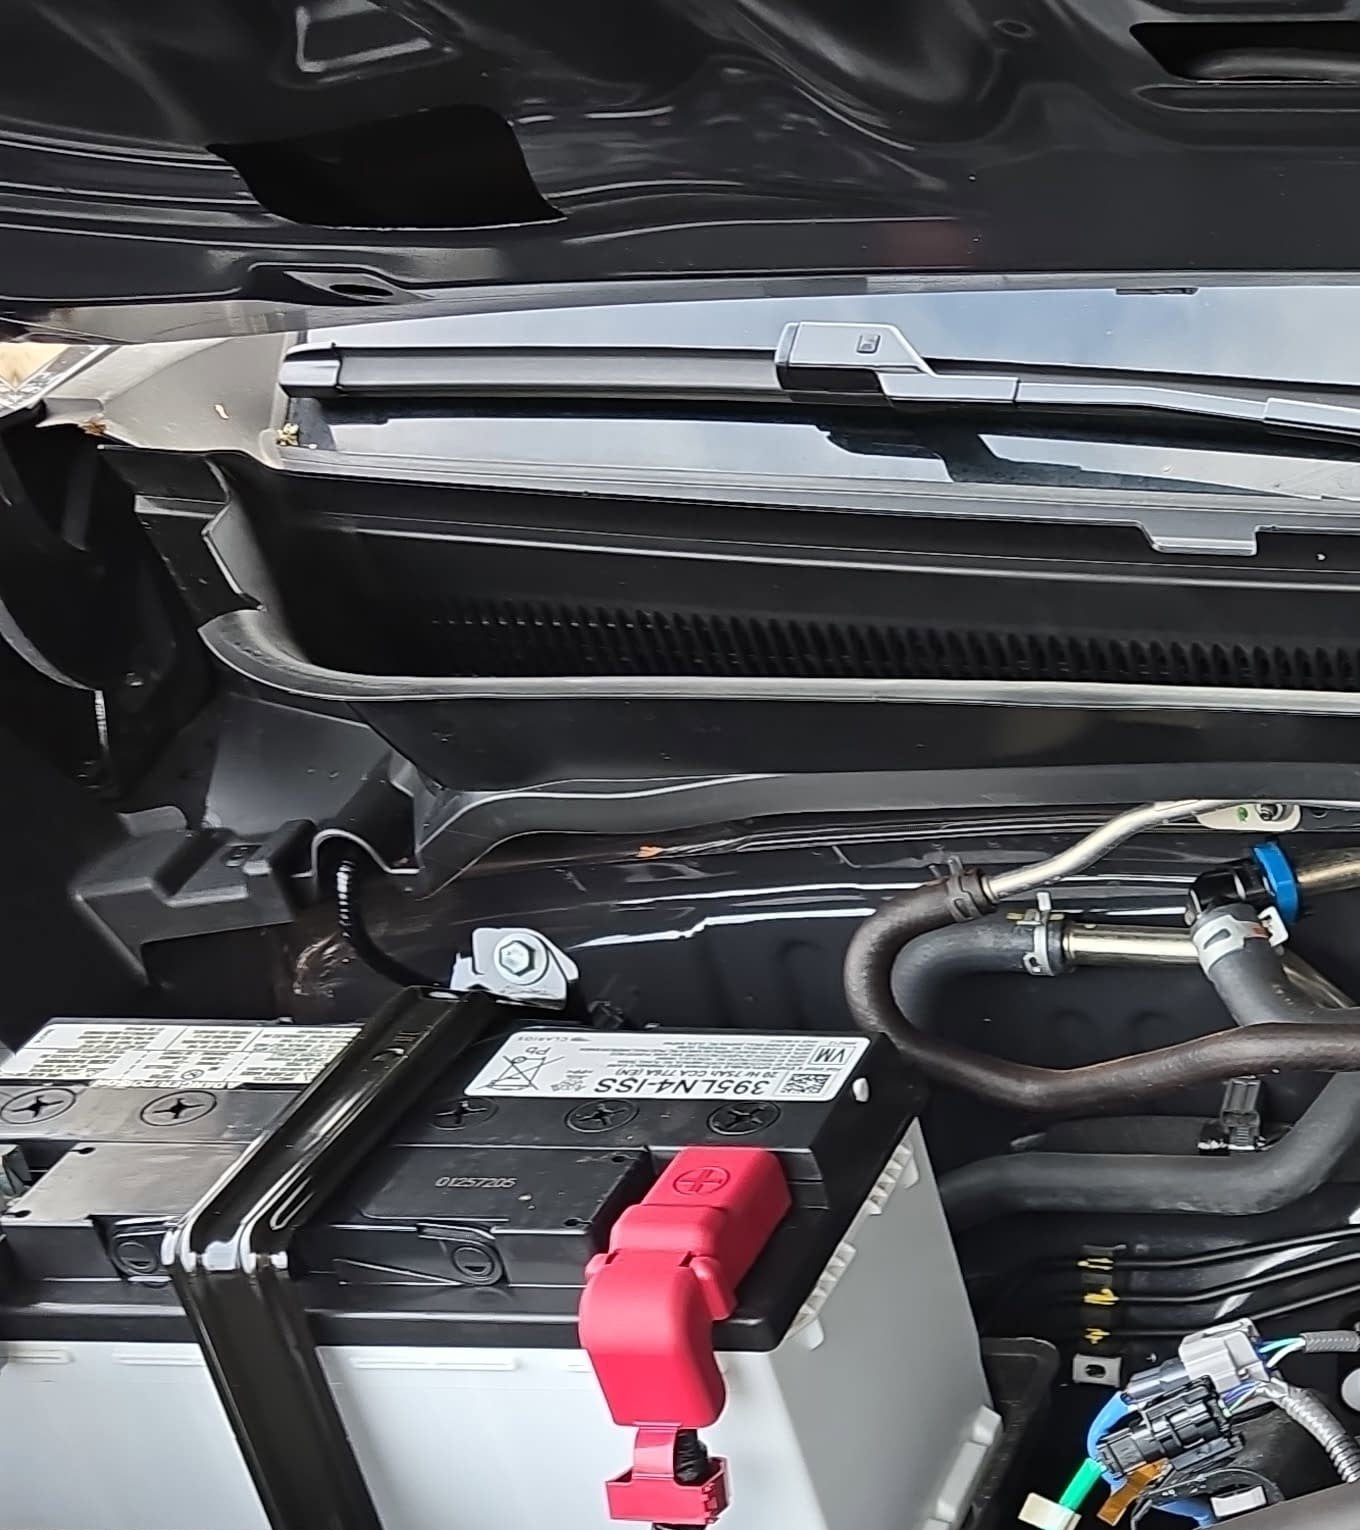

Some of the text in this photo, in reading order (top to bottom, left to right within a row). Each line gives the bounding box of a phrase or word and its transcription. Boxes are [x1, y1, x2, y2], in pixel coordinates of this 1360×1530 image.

[526, 1047, 551, 1056] Pb
[815, 1048, 846, 1063] VM
[594, 1077, 771, 1095] 395LN4-ISS
